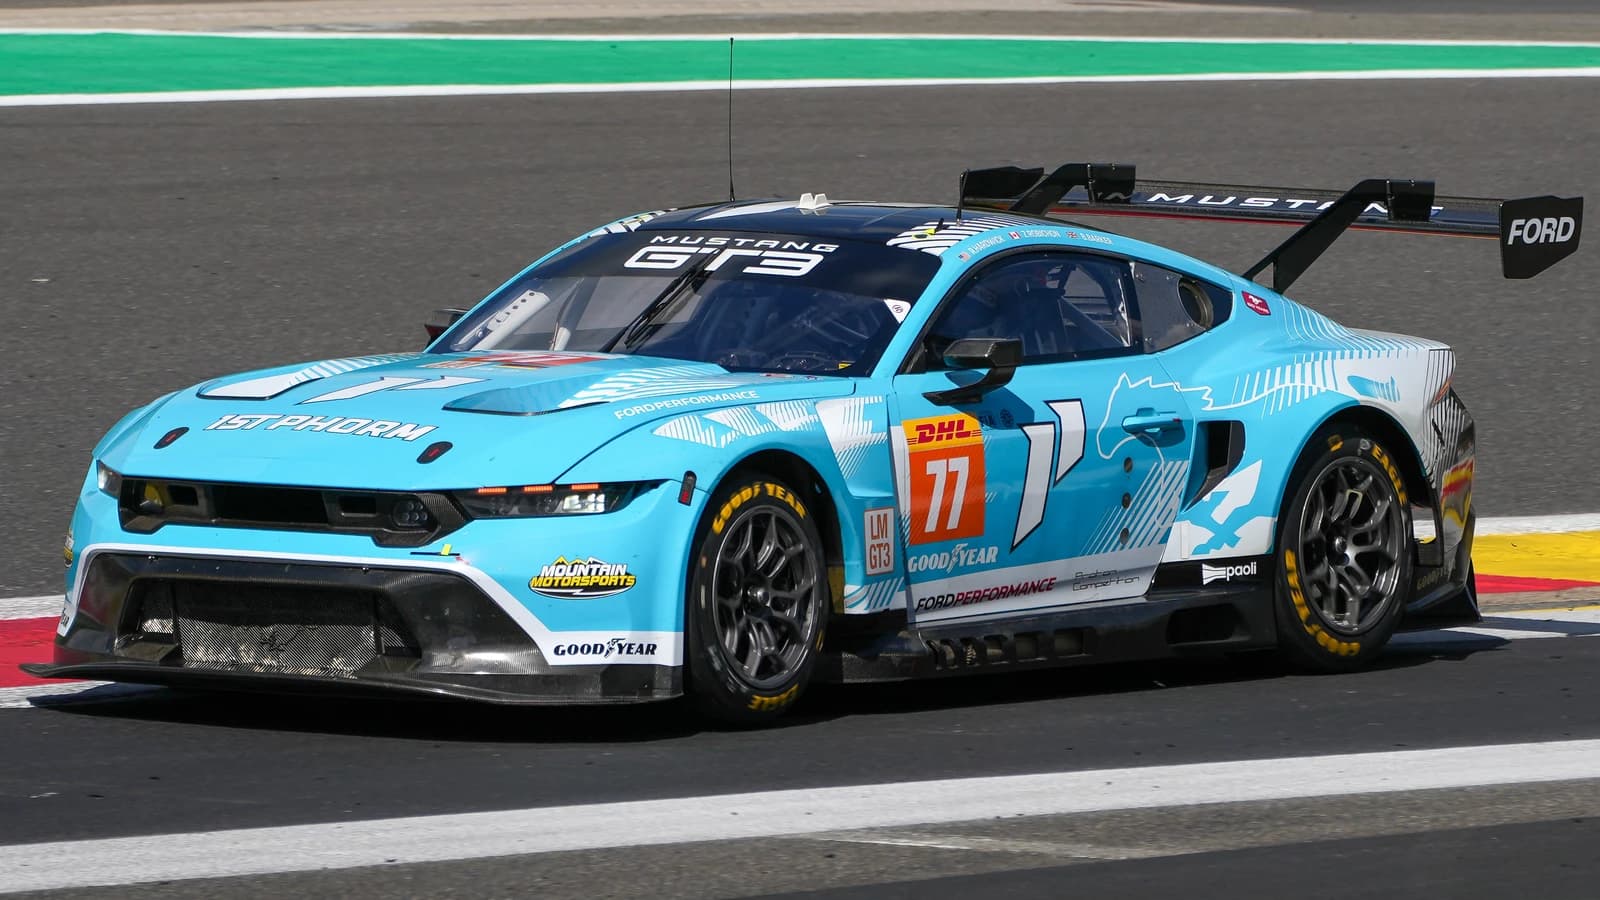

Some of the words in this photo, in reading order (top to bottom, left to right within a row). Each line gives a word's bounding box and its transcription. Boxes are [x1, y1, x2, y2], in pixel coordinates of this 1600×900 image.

[650, 235, 839, 253] MUSTANG
[1508, 216, 1575, 245] FORD
[624, 245, 824, 276] GT3
[203, 414, 283, 430] 1ST
[264, 415, 439, 442] PHORM
[914, 419, 971, 444] DHL
[924, 456, 970, 533] 77
[870, 513, 888, 540] LM
[869, 542, 890, 569] GT3
[530, 575, 636, 588] MOTORSPORTS
[540, 564, 628, 577] MOUNTAIN
[1226, 562, 1257, 581] paoli
